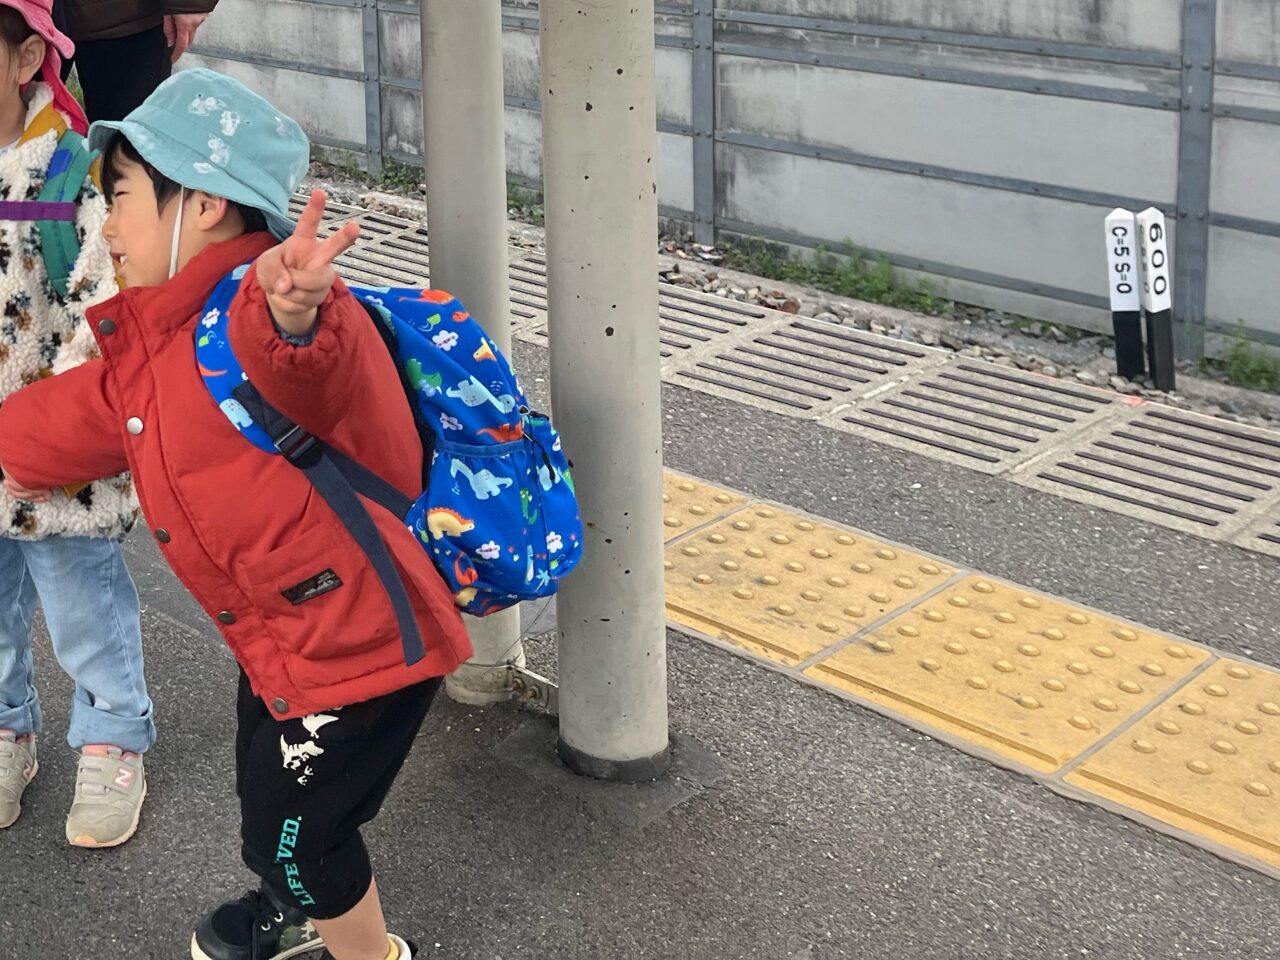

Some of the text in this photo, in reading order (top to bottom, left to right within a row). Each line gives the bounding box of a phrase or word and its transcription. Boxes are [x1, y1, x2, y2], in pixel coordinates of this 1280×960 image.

[1149, 222, 1167, 295] 600
[273, 815, 315, 906] LIFE VED.
